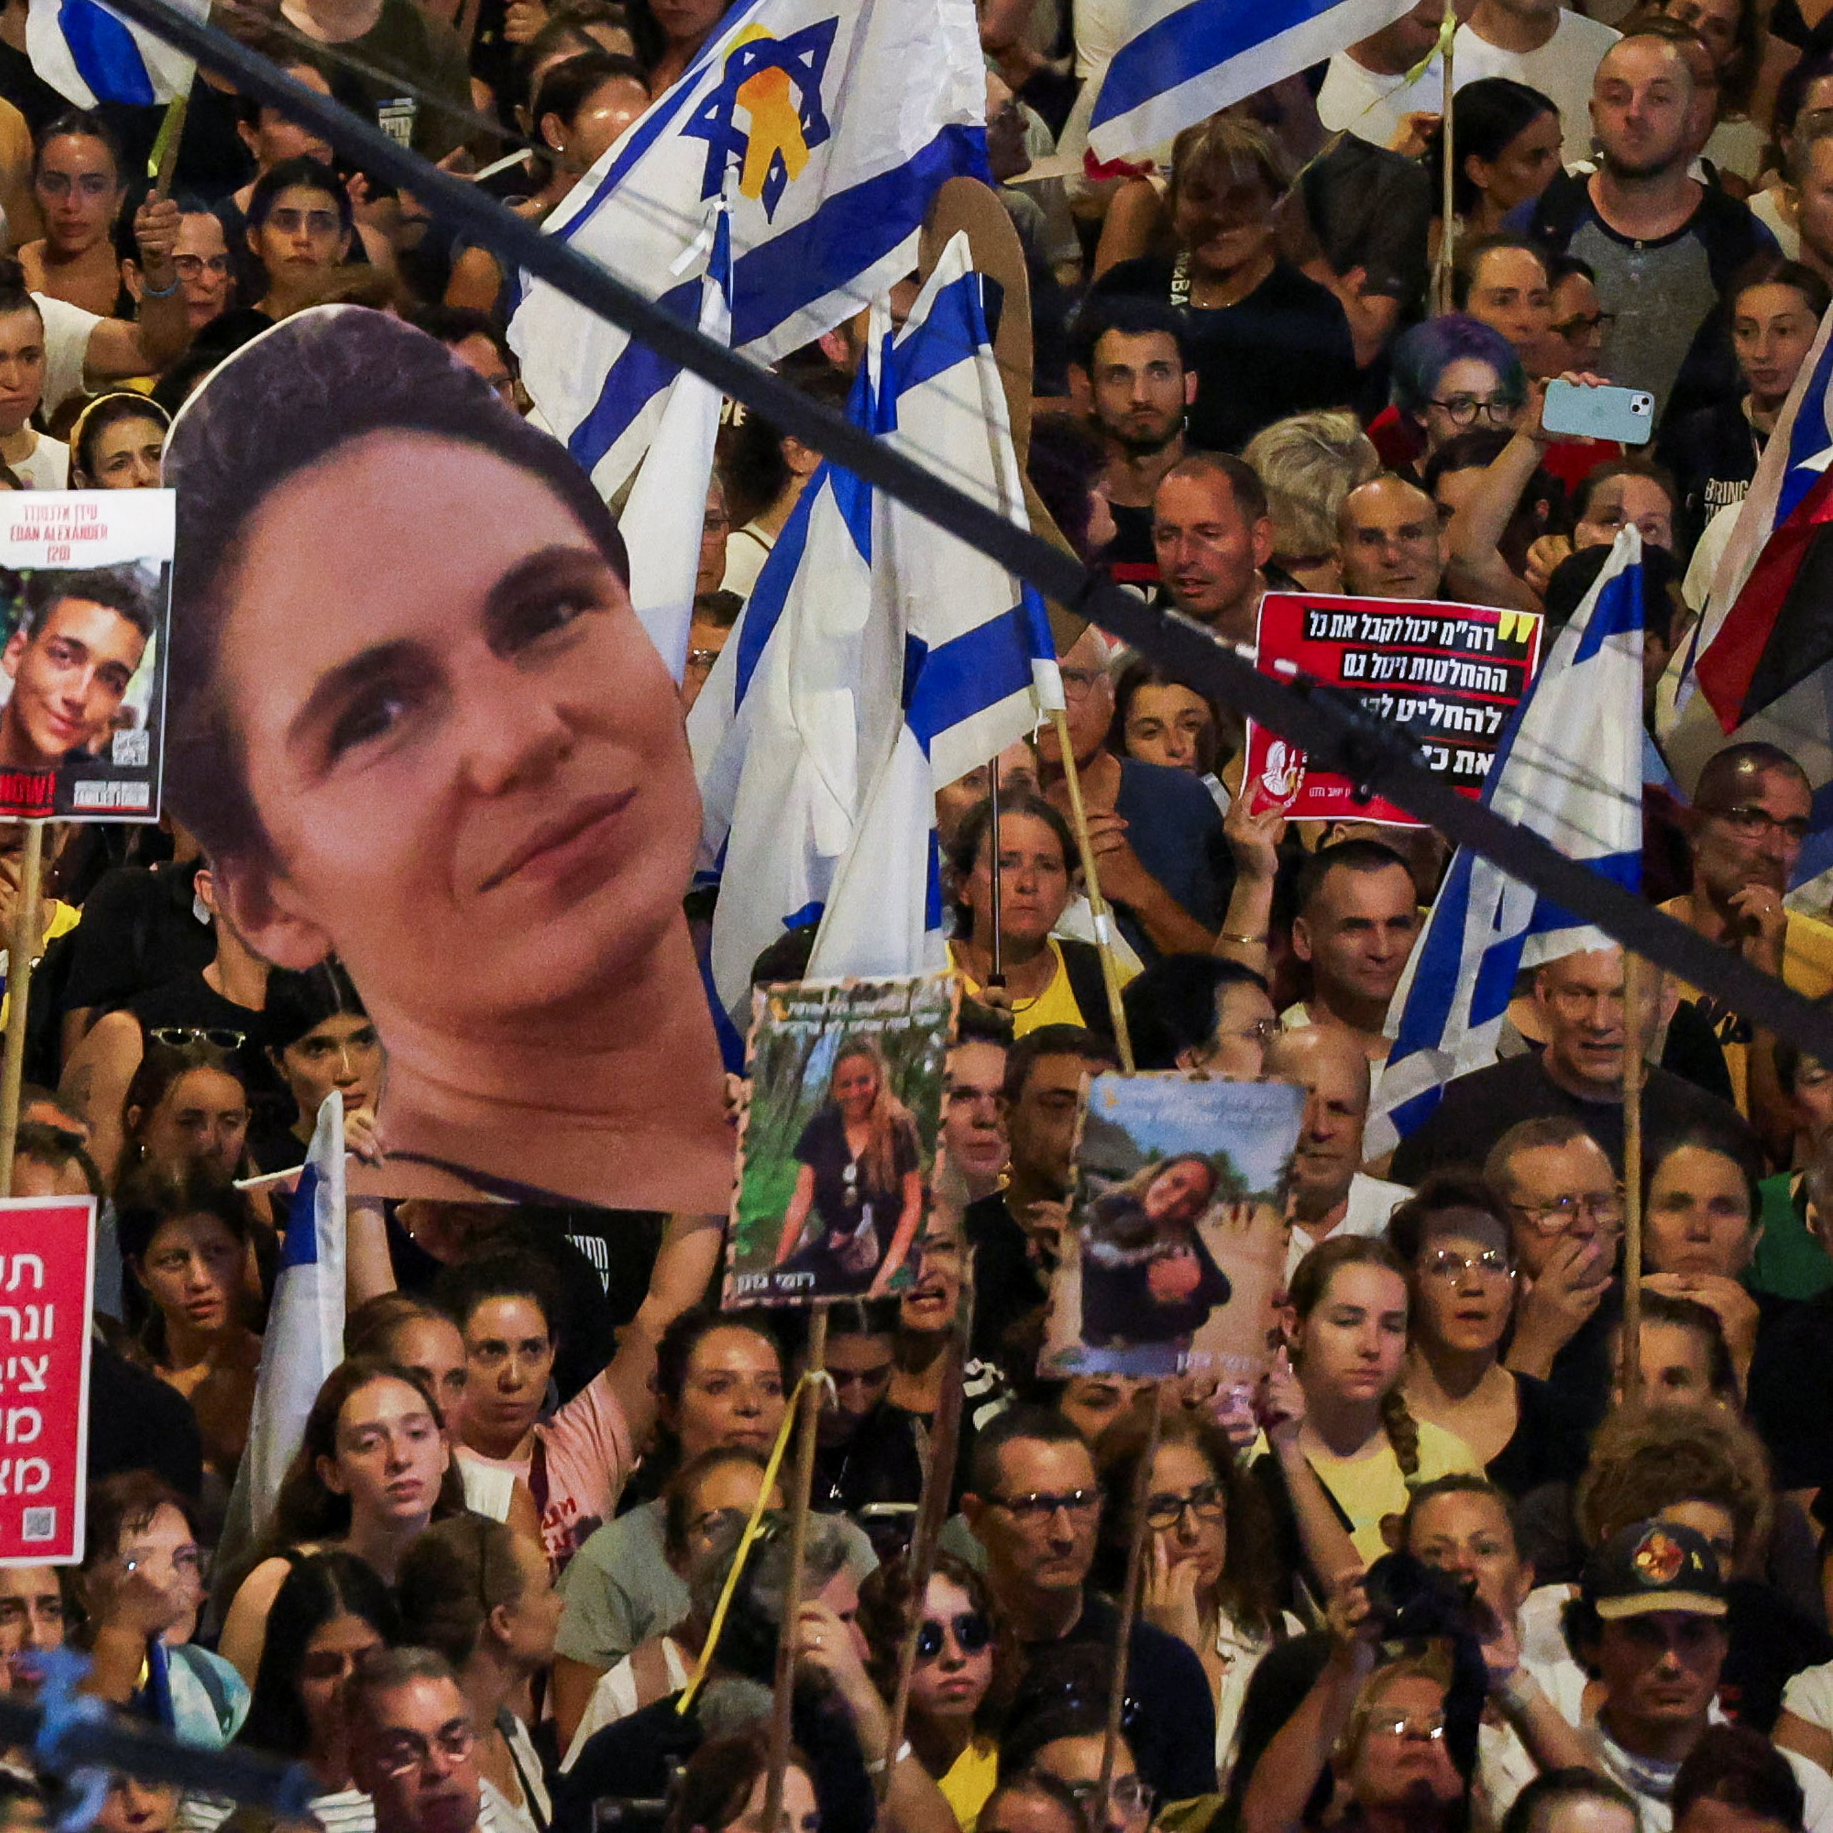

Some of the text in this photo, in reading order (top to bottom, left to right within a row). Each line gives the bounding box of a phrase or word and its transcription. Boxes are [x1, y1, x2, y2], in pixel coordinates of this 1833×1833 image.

[1331, 613, 1358, 638] את
[1343, 653, 1367, 678] גם
[1407, 656, 1508, 693] ההחלטות
[1395, 697, 1503, 735] להחליט
[1452, 749, 1496, 776] את
